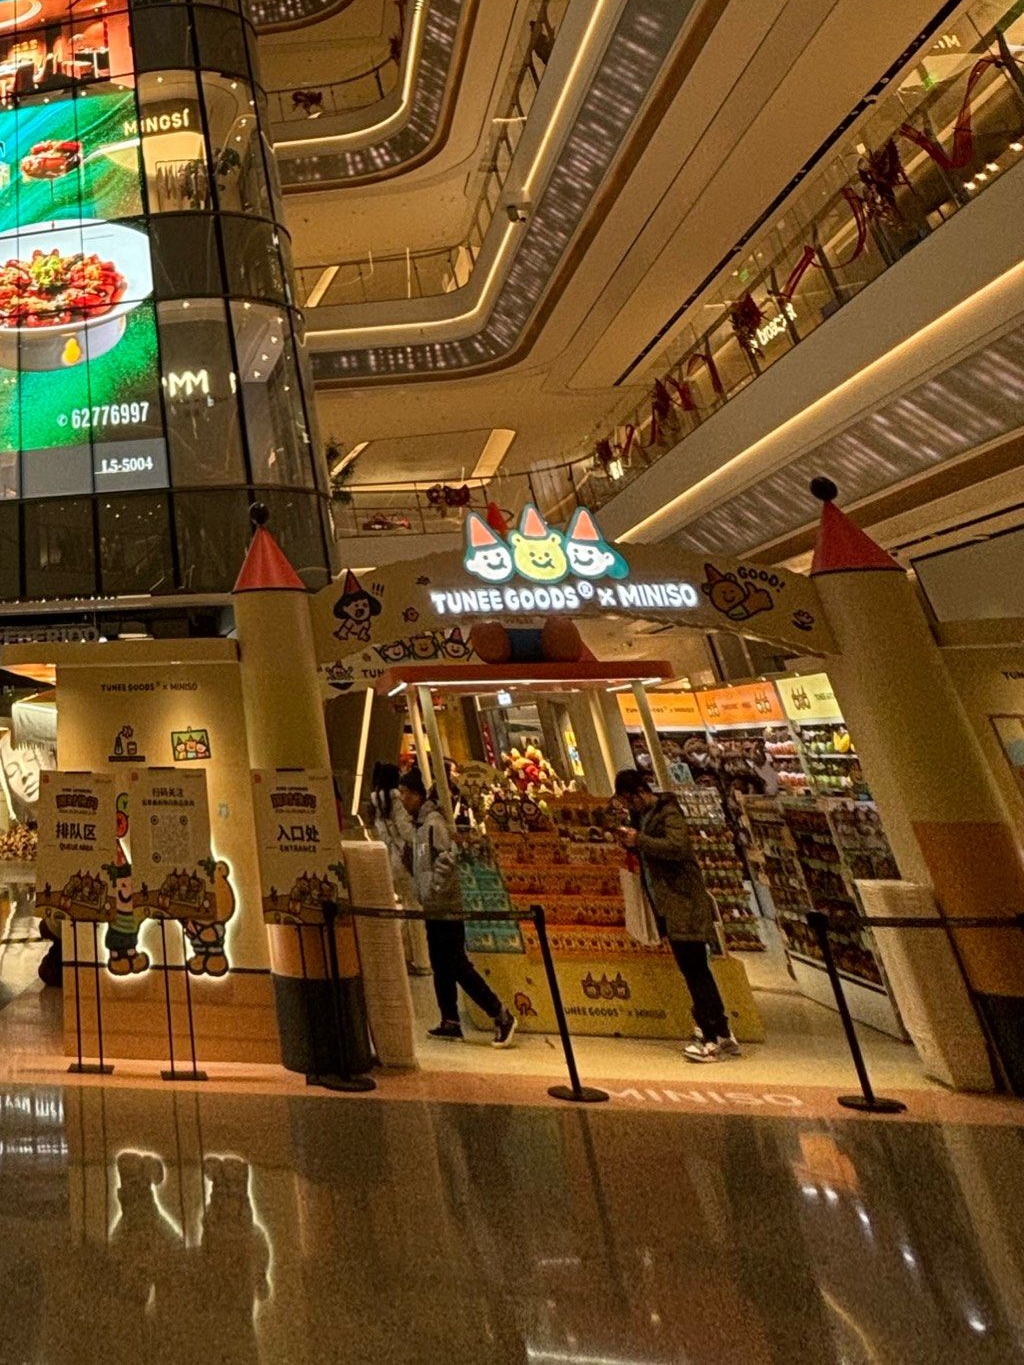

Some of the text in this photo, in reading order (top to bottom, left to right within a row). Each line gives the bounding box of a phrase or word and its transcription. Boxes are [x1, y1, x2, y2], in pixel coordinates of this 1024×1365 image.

[71, 401, 149, 428] 62776997
[430, 588, 503, 614] TUNEE
[618, 583, 698, 608] MINISO
[56, 821, 97, 841] 排队区
[277, 824, 320, 843] 入口处
